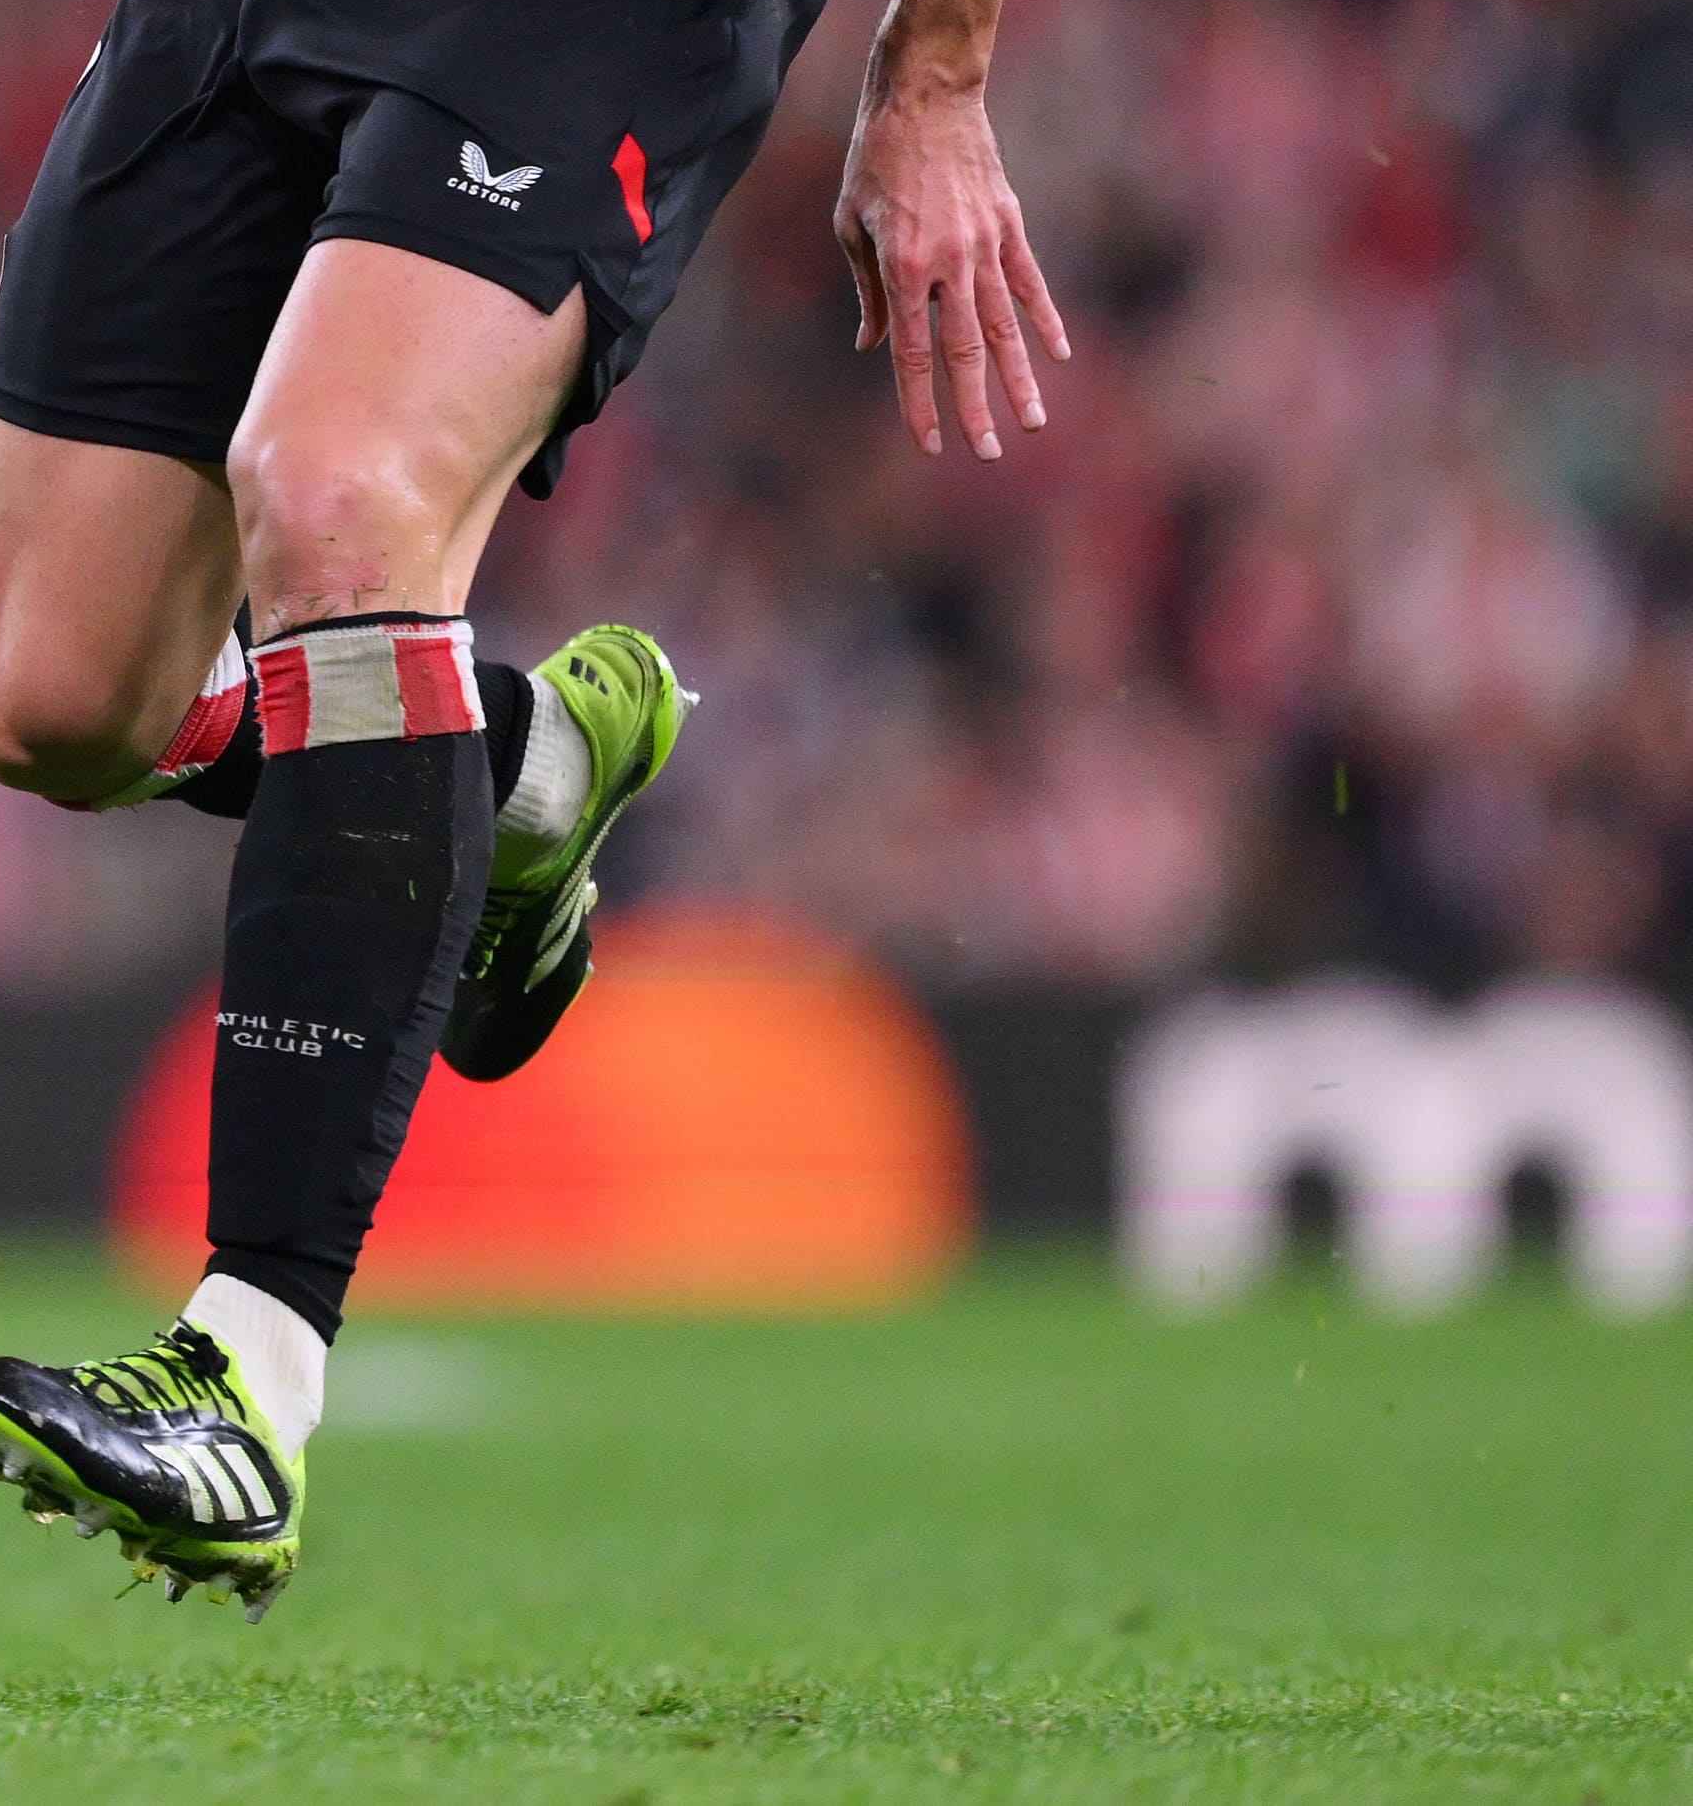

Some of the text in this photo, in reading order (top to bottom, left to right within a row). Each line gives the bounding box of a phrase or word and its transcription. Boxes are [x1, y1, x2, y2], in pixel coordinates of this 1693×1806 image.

[447, 177, 521, 212] CASTORE
[214, 1011, 366, 1050] ATHLETIC
[232, 1032, 323, 1057] CLUB
